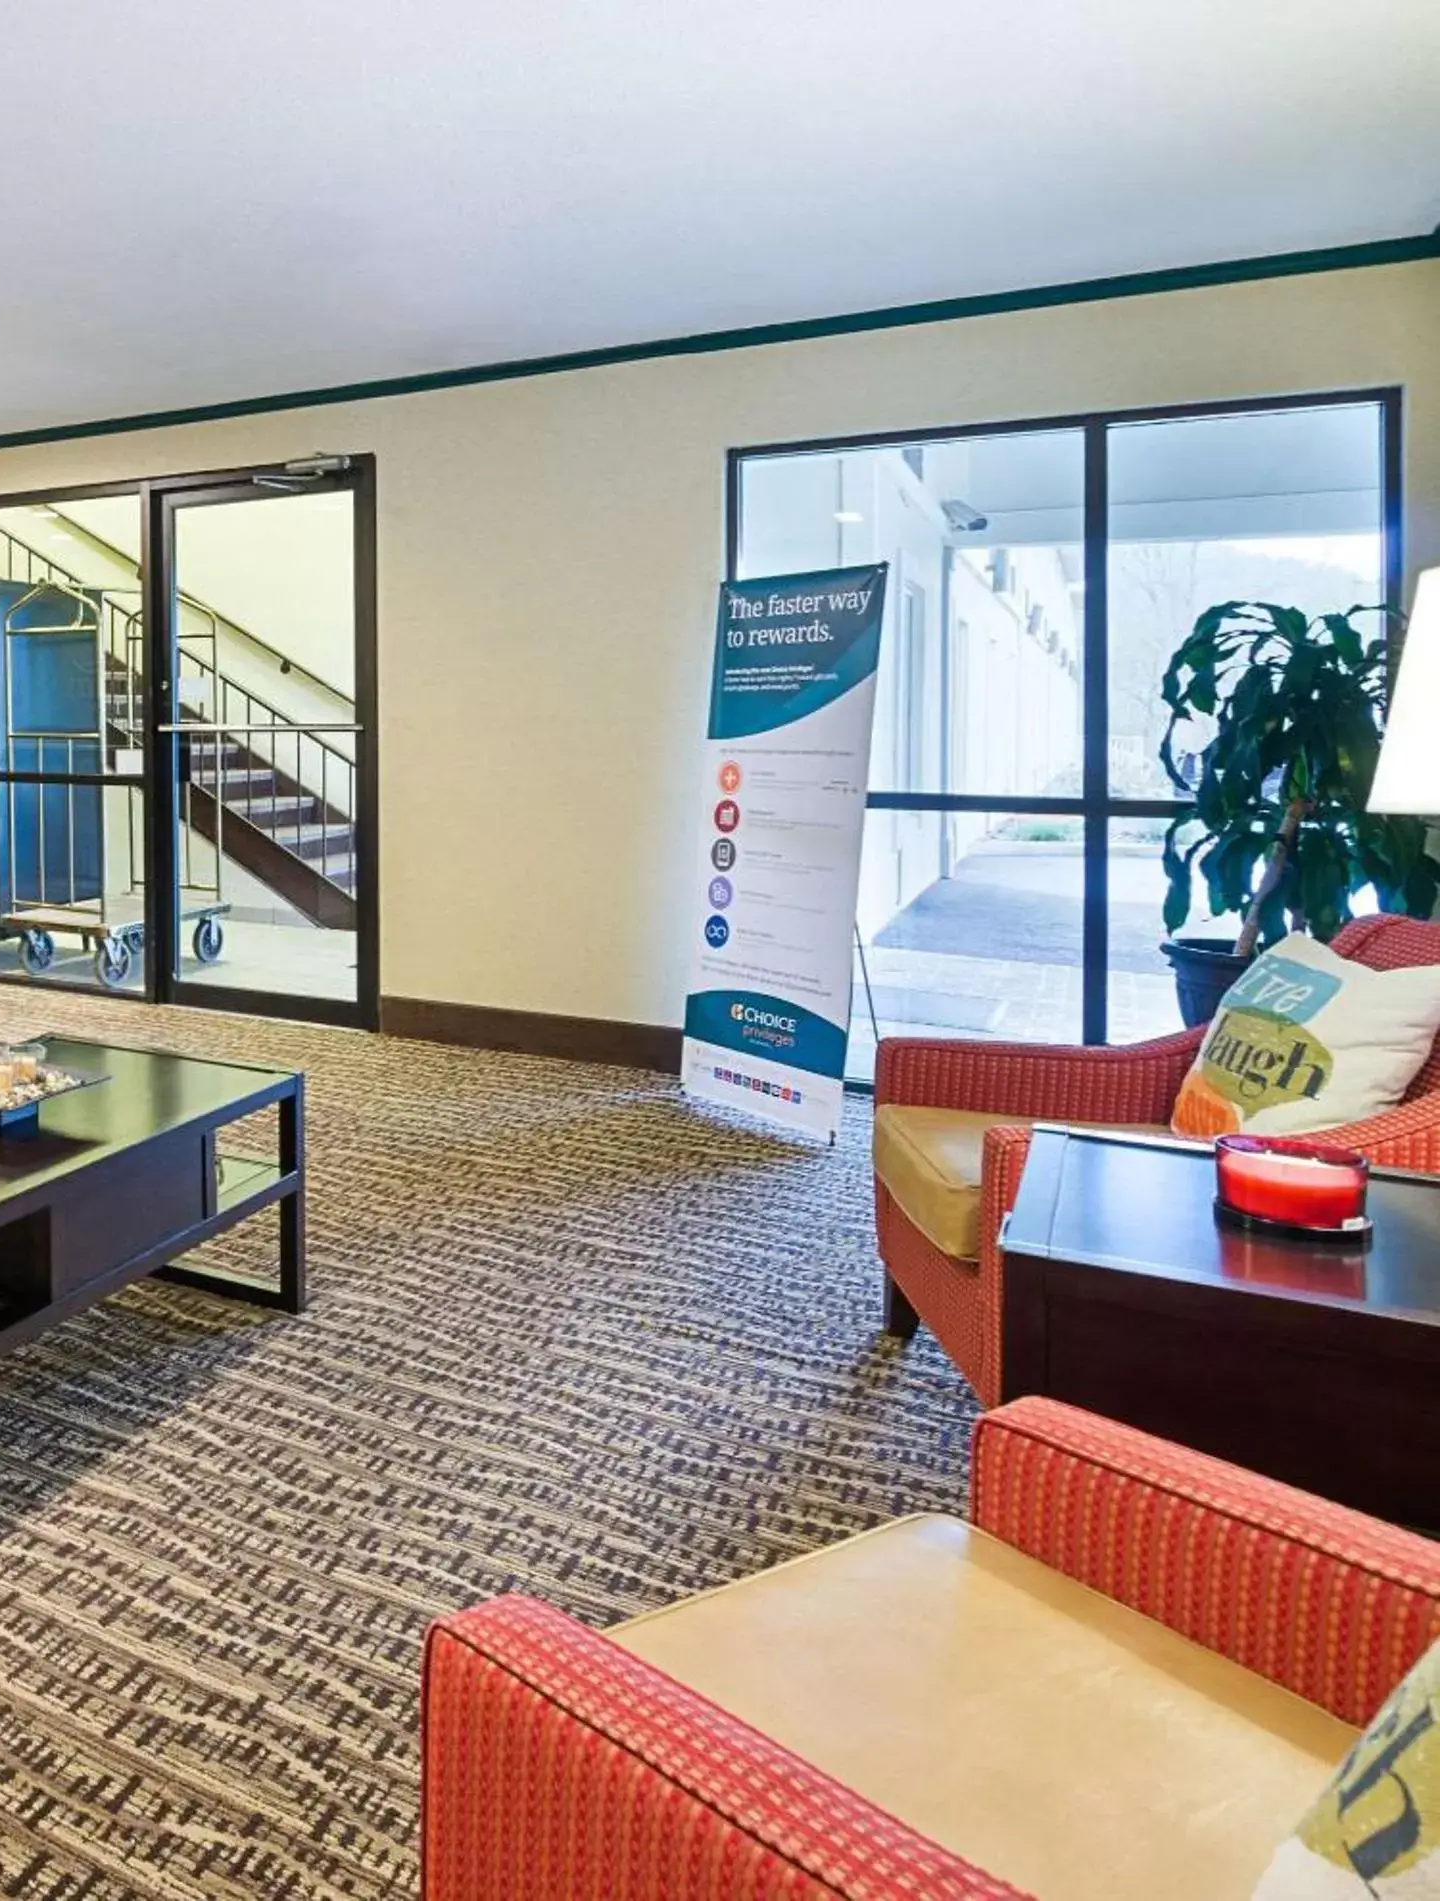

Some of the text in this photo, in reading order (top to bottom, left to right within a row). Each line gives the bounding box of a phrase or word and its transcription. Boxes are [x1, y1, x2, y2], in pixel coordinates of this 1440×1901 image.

[728, 590, 872, 619] The faster way
[727, 620, 834, 648] to rewards.
[744, 1007, 797, 1032] CHOICE
[1203, 1012, 1326, 1101] laugh
